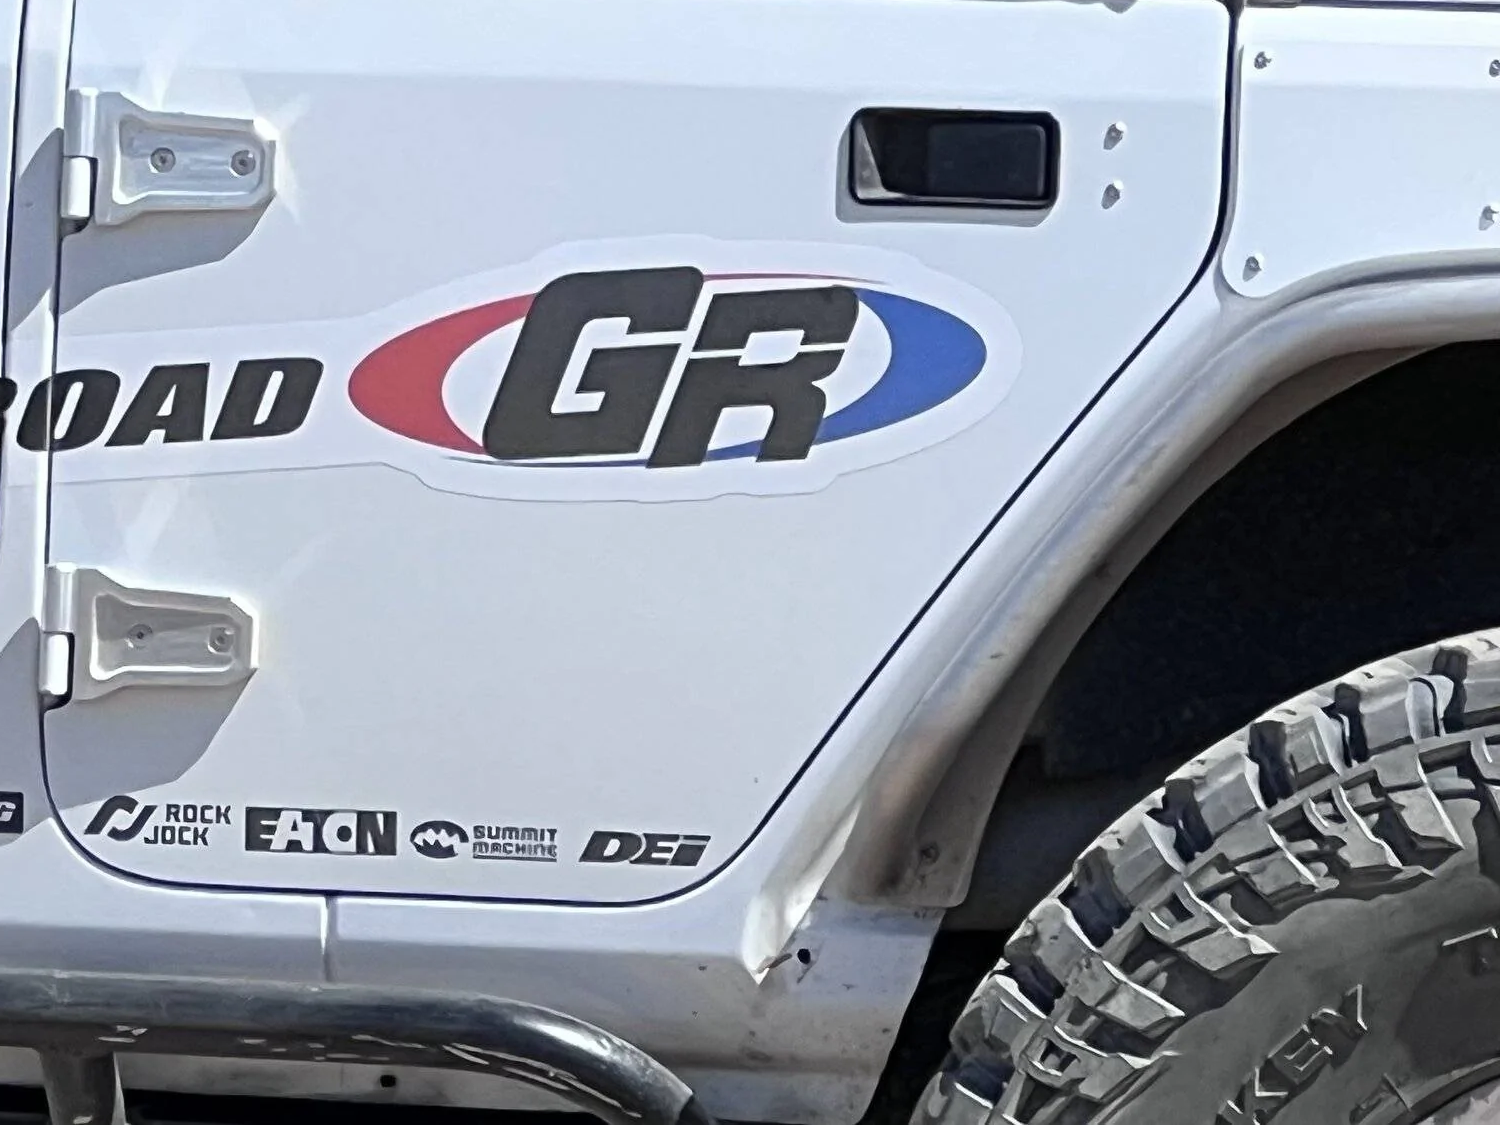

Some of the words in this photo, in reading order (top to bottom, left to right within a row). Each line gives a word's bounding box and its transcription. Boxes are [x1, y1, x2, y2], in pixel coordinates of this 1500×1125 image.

[481, 266, 858, 469] GR
[166, 803, 232, 825] ROCK
[143, 825, 209, 847] JOCK
[246, 807, 397, 856] EATON
[473, 825, 558, 842] SUMMIT
